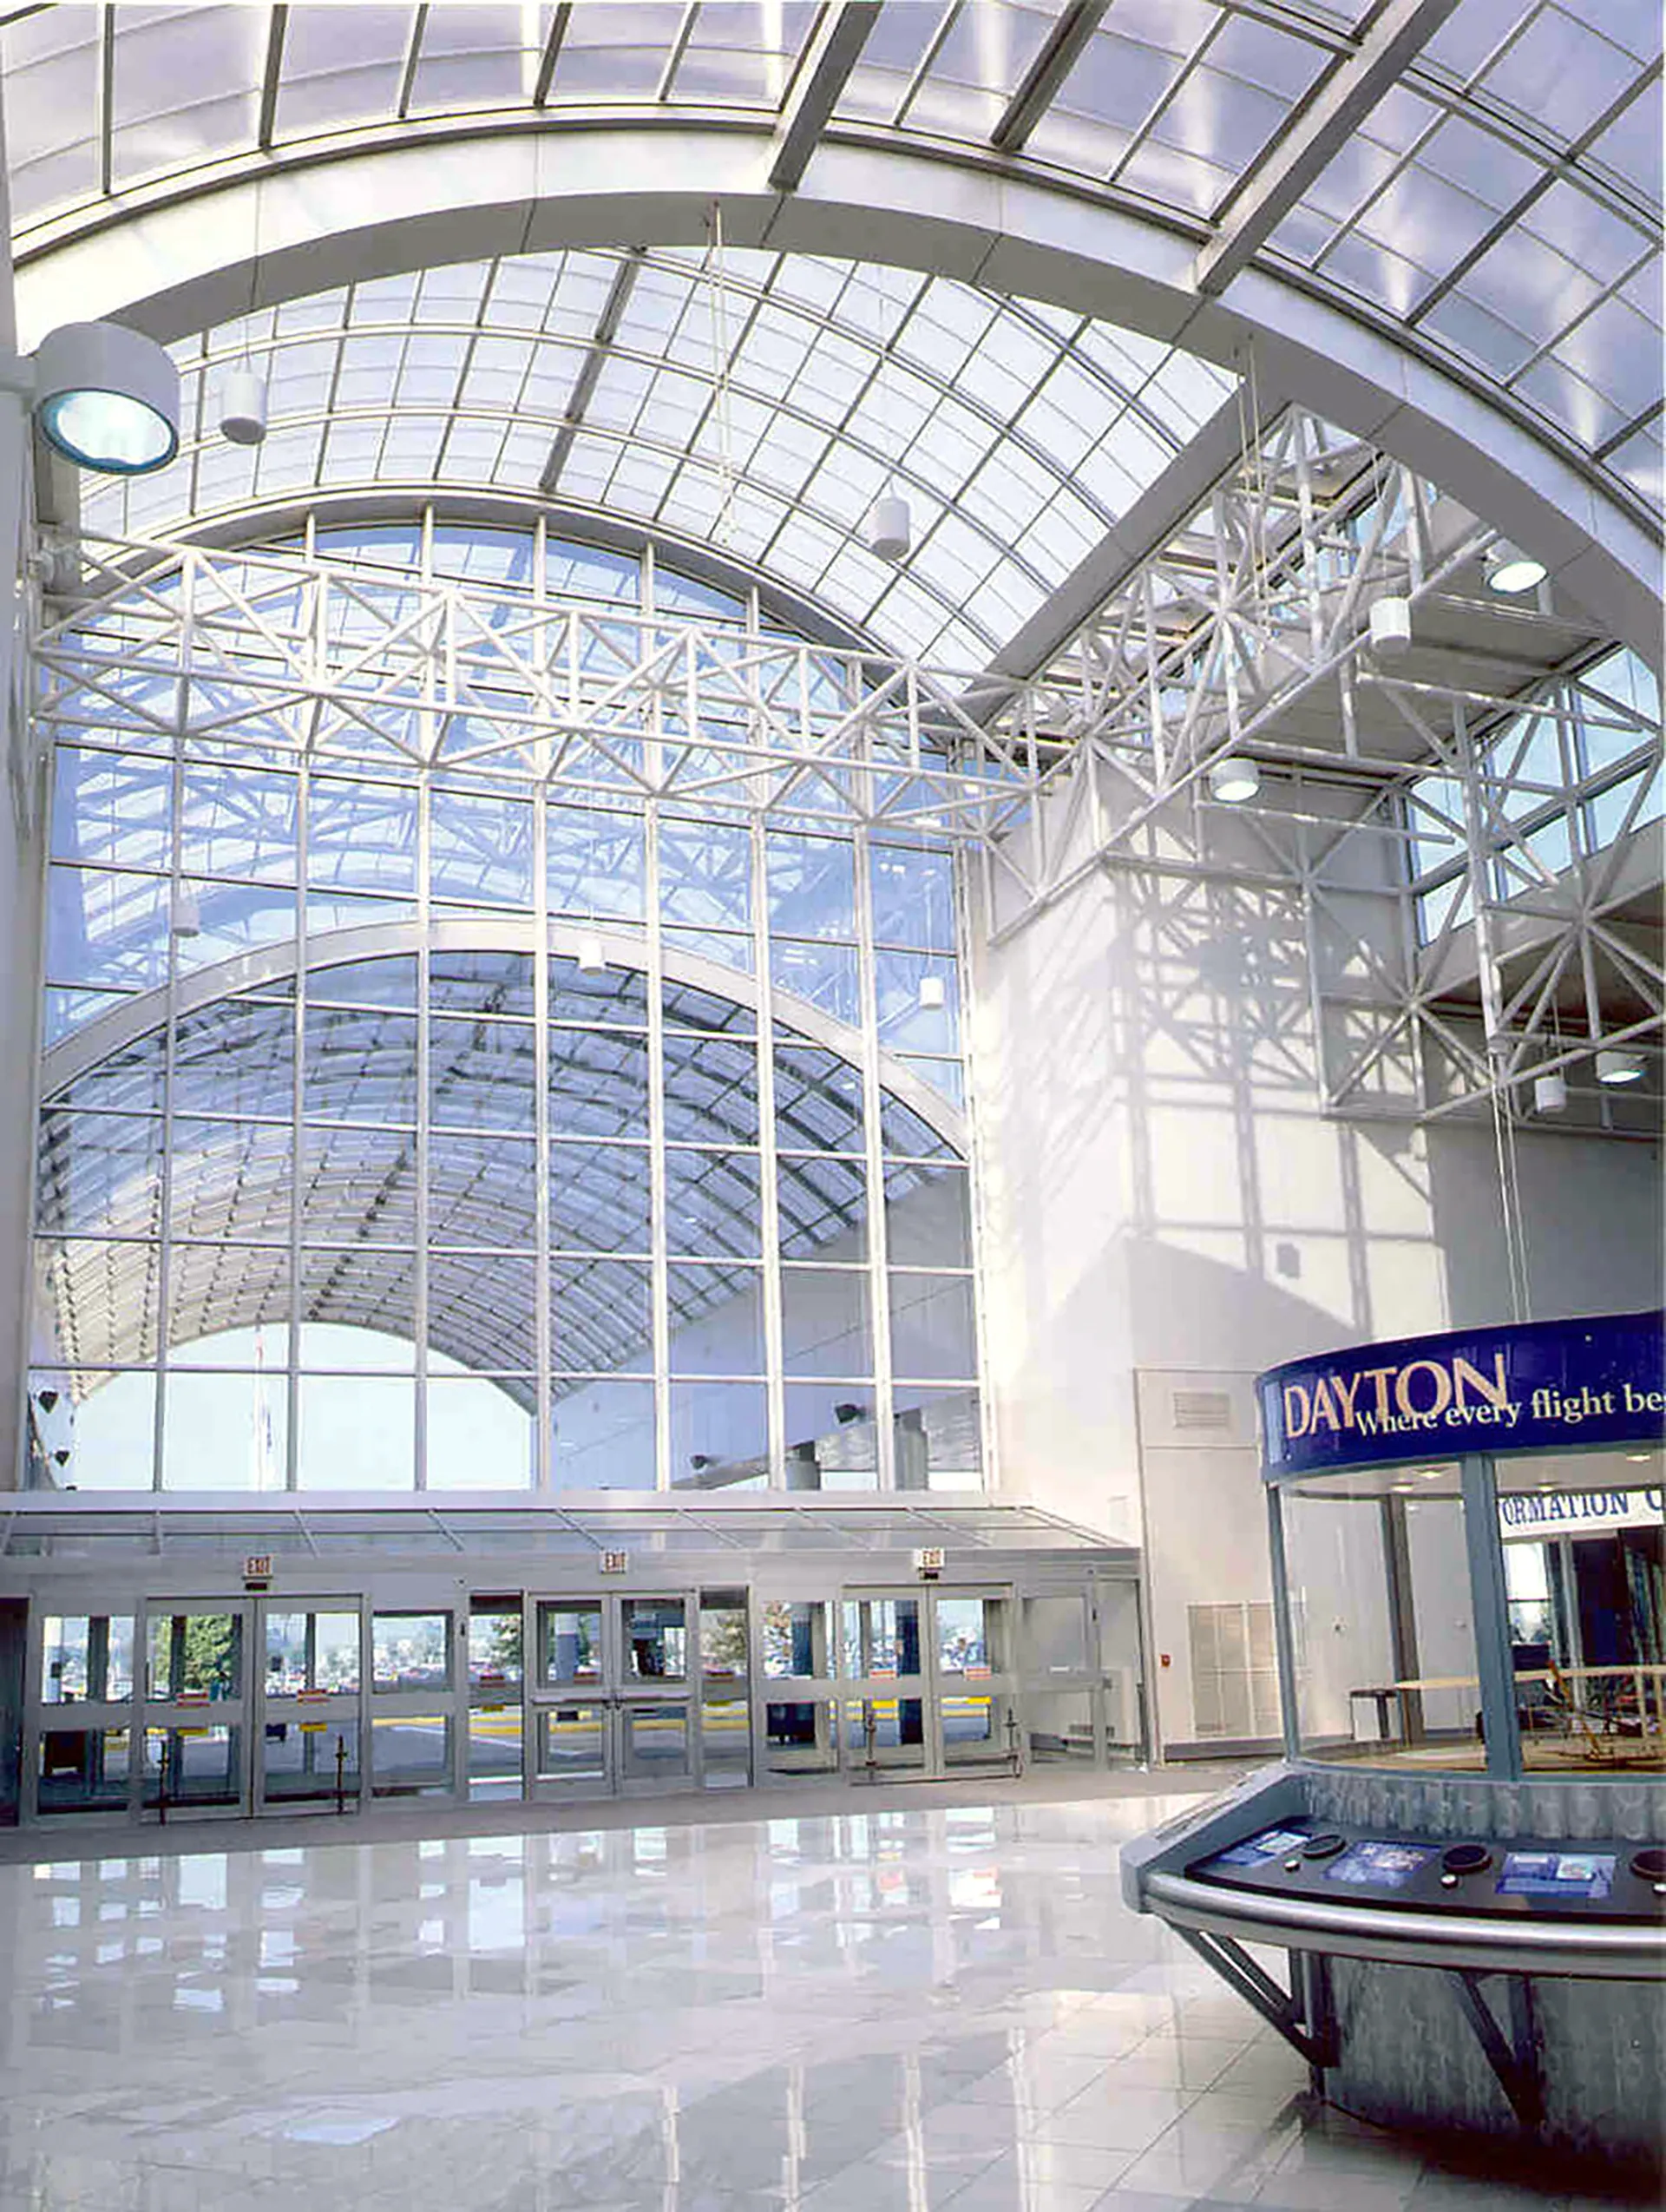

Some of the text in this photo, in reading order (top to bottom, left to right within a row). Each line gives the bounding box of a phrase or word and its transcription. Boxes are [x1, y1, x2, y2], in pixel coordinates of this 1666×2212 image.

[1284, 1352, 1508, 1440] DAYTON
[1354, 1382, 1664, 1437] Where every flight be
[246, 1555, 272, 1574] EXIT
